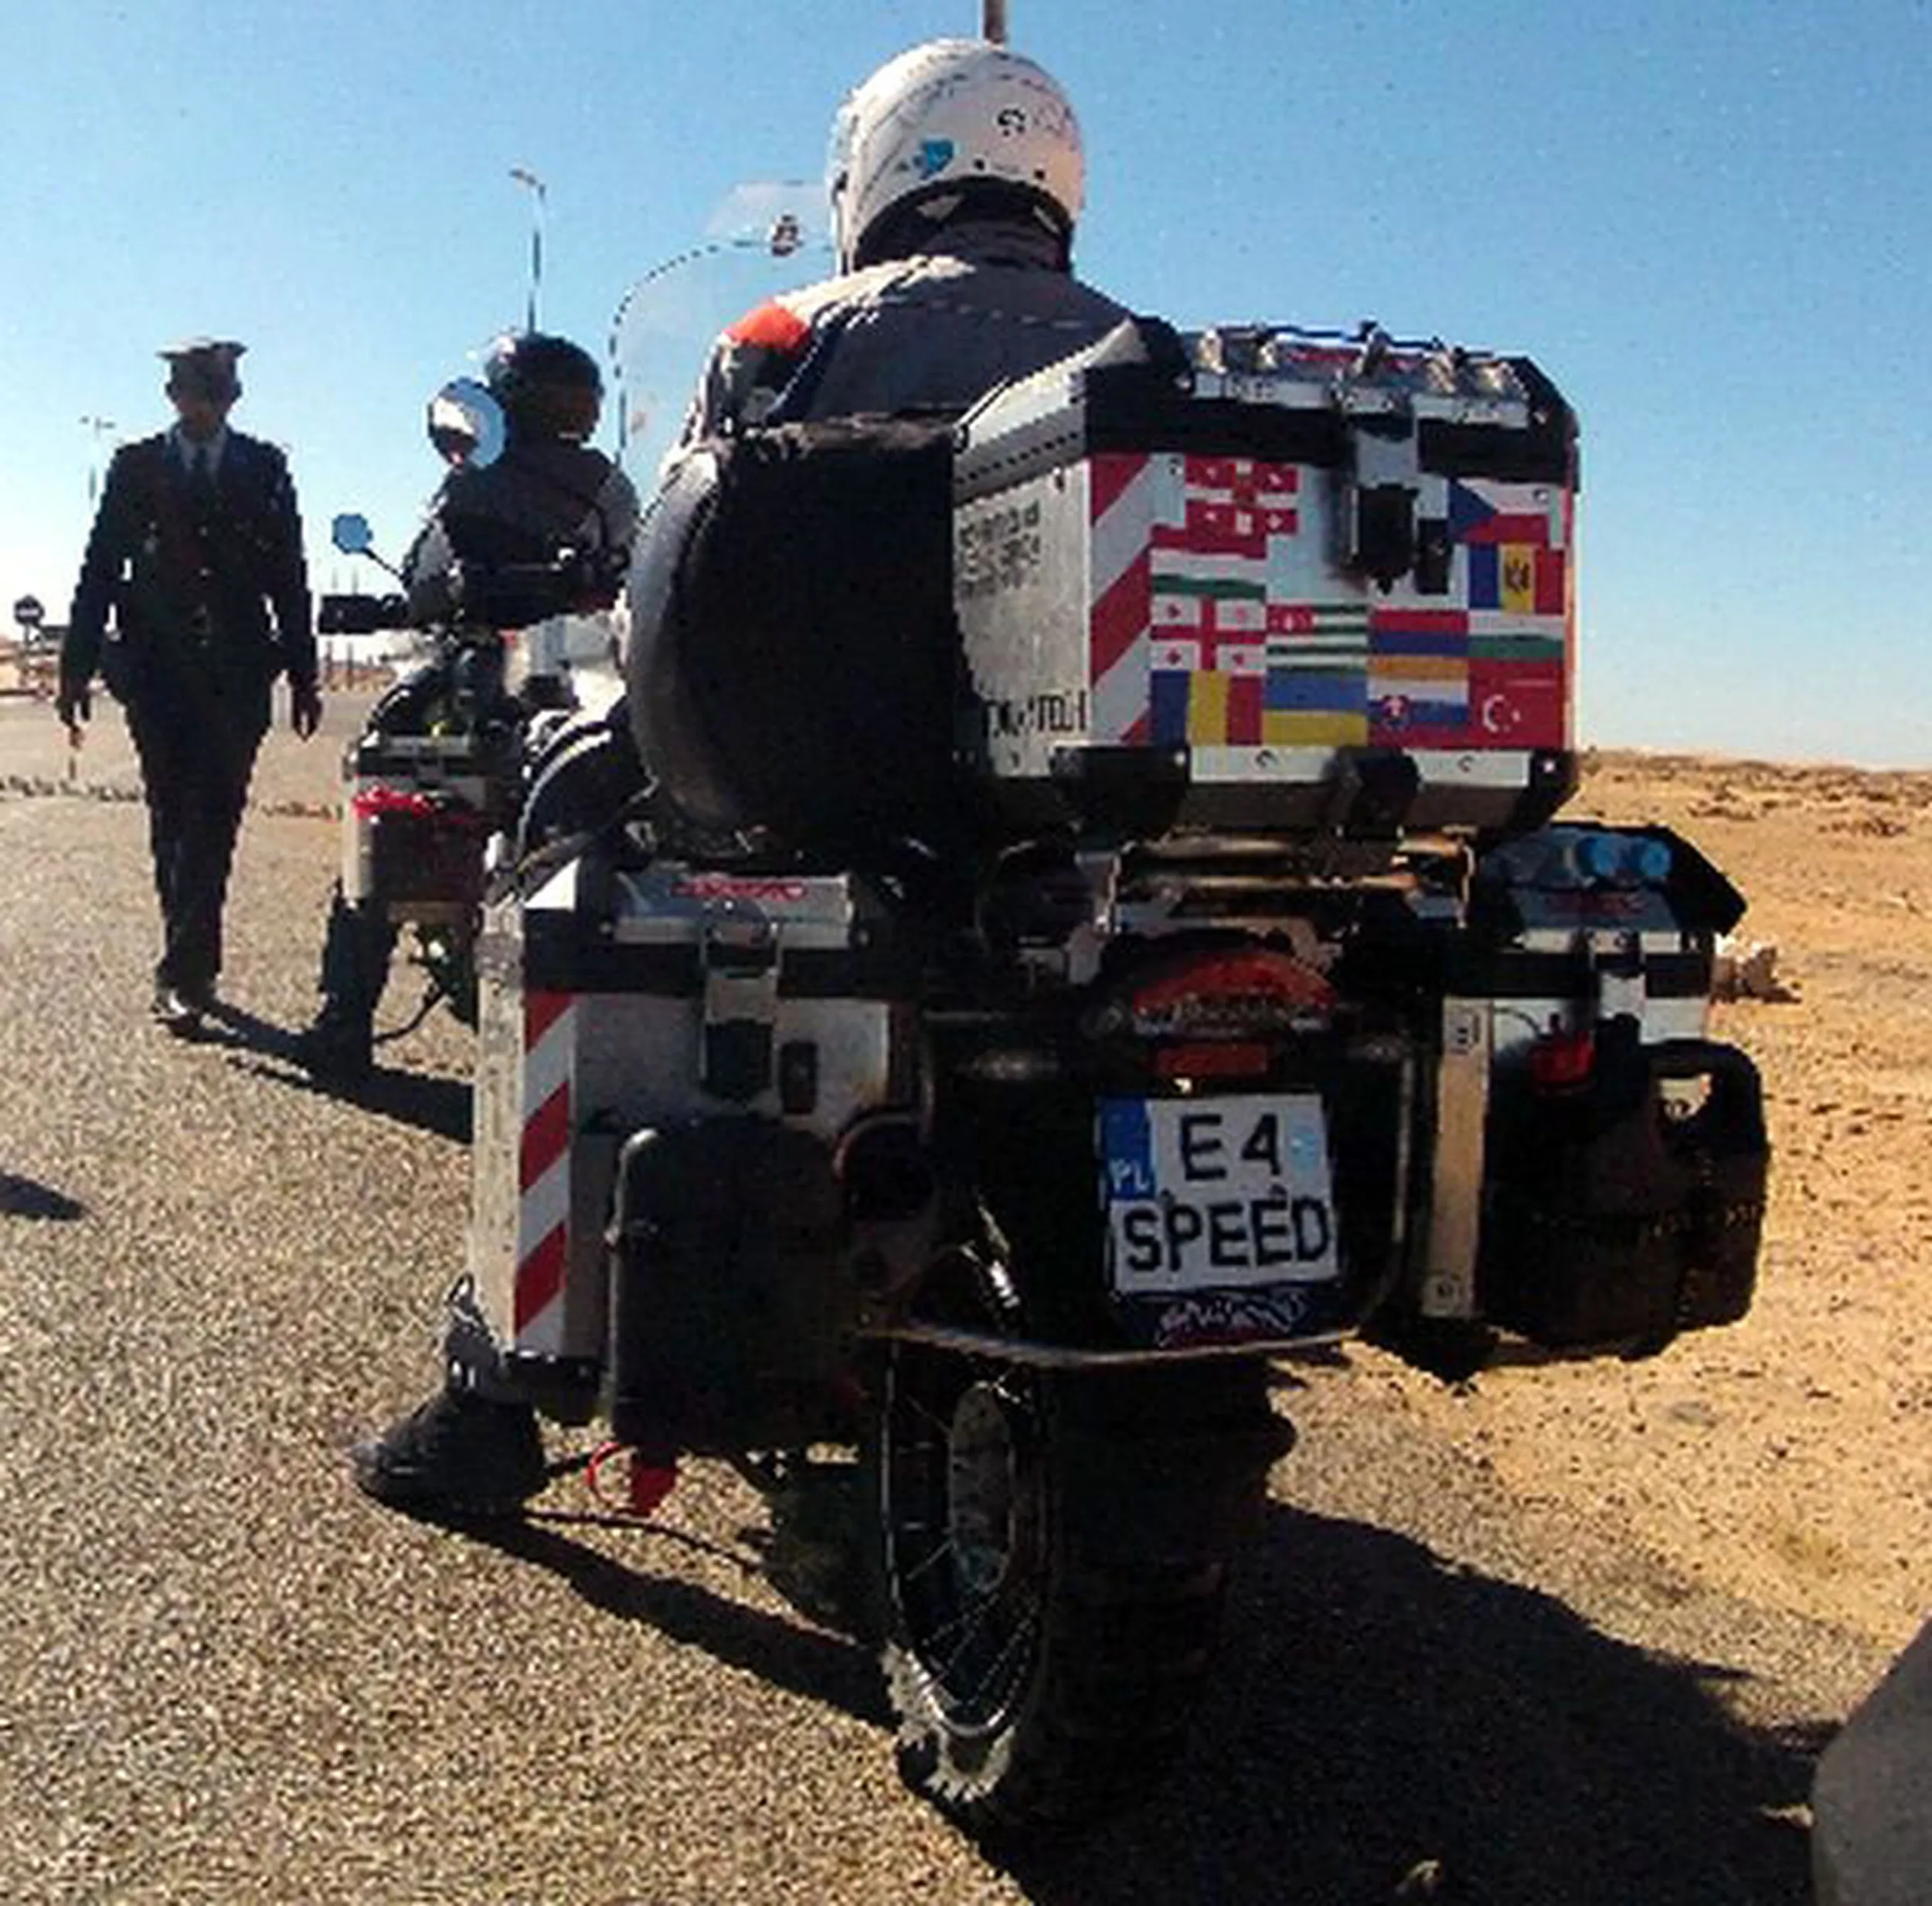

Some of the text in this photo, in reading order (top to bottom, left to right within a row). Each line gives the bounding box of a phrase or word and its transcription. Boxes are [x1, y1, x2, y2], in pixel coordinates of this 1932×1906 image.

[1109, 1160, 1150, 1193] PL
[1180, 1114, 1281, 1181] E4
[1124, 1198, 1331, 1272] SPEED
